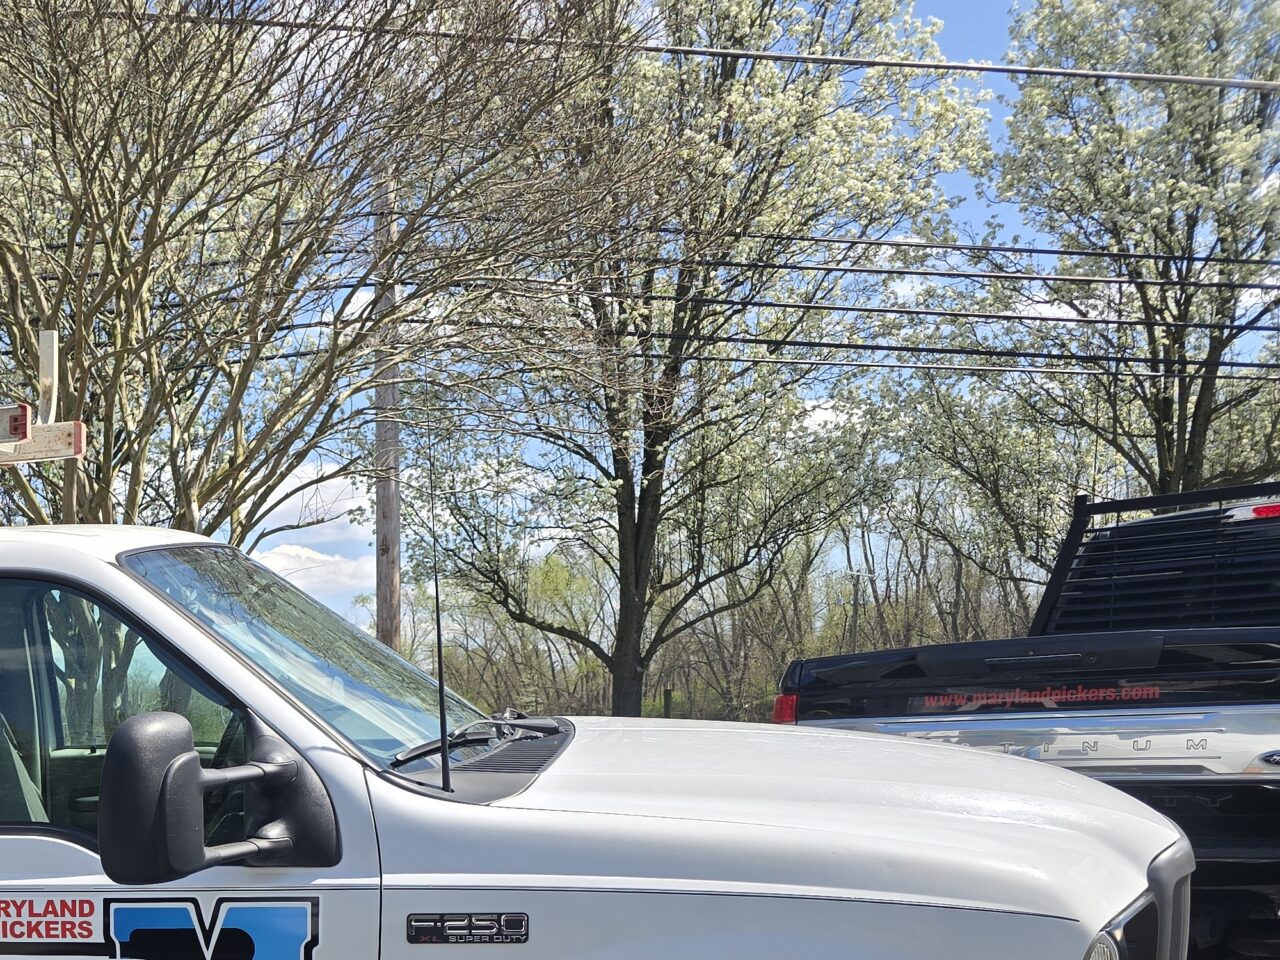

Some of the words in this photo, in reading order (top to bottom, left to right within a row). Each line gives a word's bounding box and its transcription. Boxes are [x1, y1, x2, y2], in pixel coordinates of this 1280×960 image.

[408, 914, 528, 936] F-250
[448, 935, 490, 943] SUPER
[494, 935, 527, 943] DUTY
